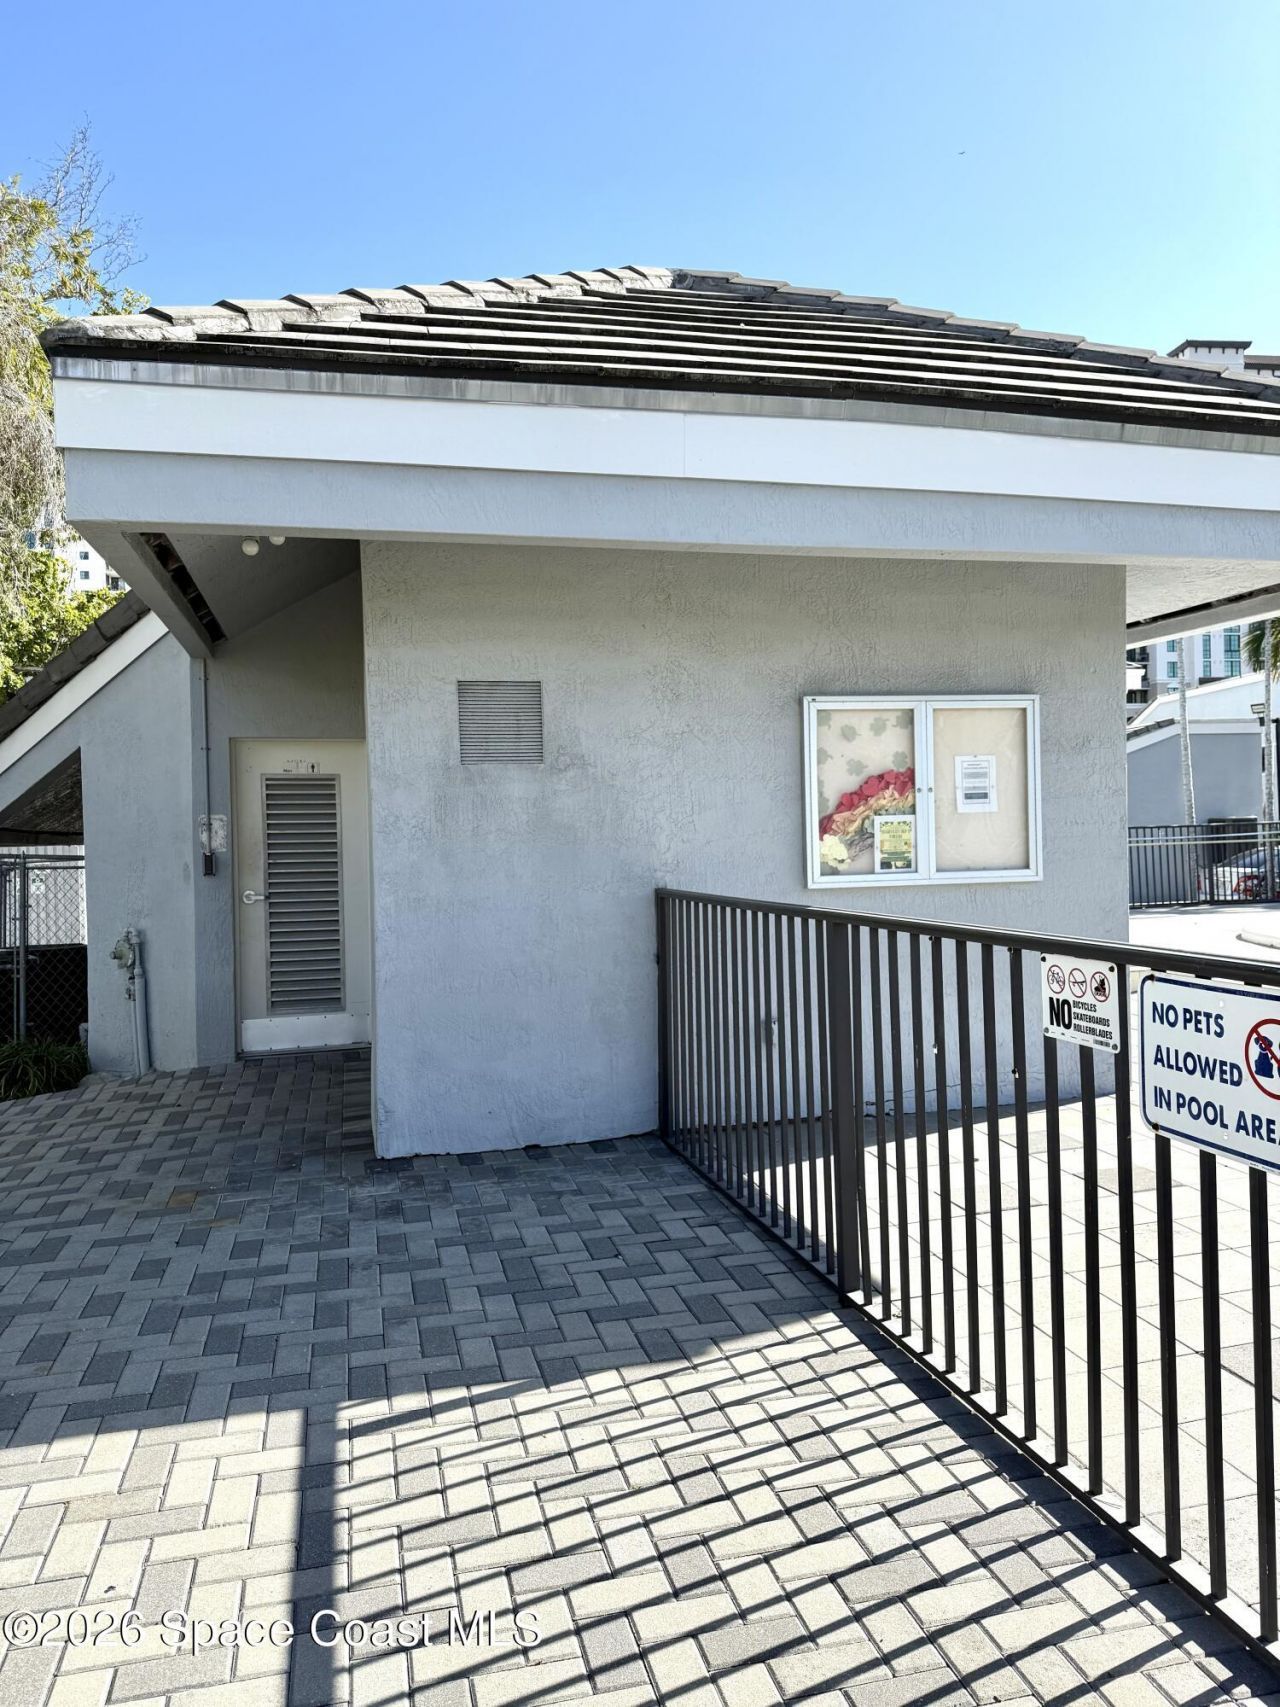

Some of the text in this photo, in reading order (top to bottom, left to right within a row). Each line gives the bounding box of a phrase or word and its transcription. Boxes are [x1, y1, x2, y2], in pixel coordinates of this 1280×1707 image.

[1048, 997, 1072, 1030] NO
[1072, 1000, 1097, 1012] BICYCLES
[1072, 1011, 1110, 1027] SKATEBOARDS
[1152, 1001, 1225, 1039] NO PETS
[1073, 1023, 1113, 1040] ROLLERBLADES
[1153, 1044, 1243, 1087] ALLOWED
[1153, 1085, 1280, 1146] IN POOL ARE
